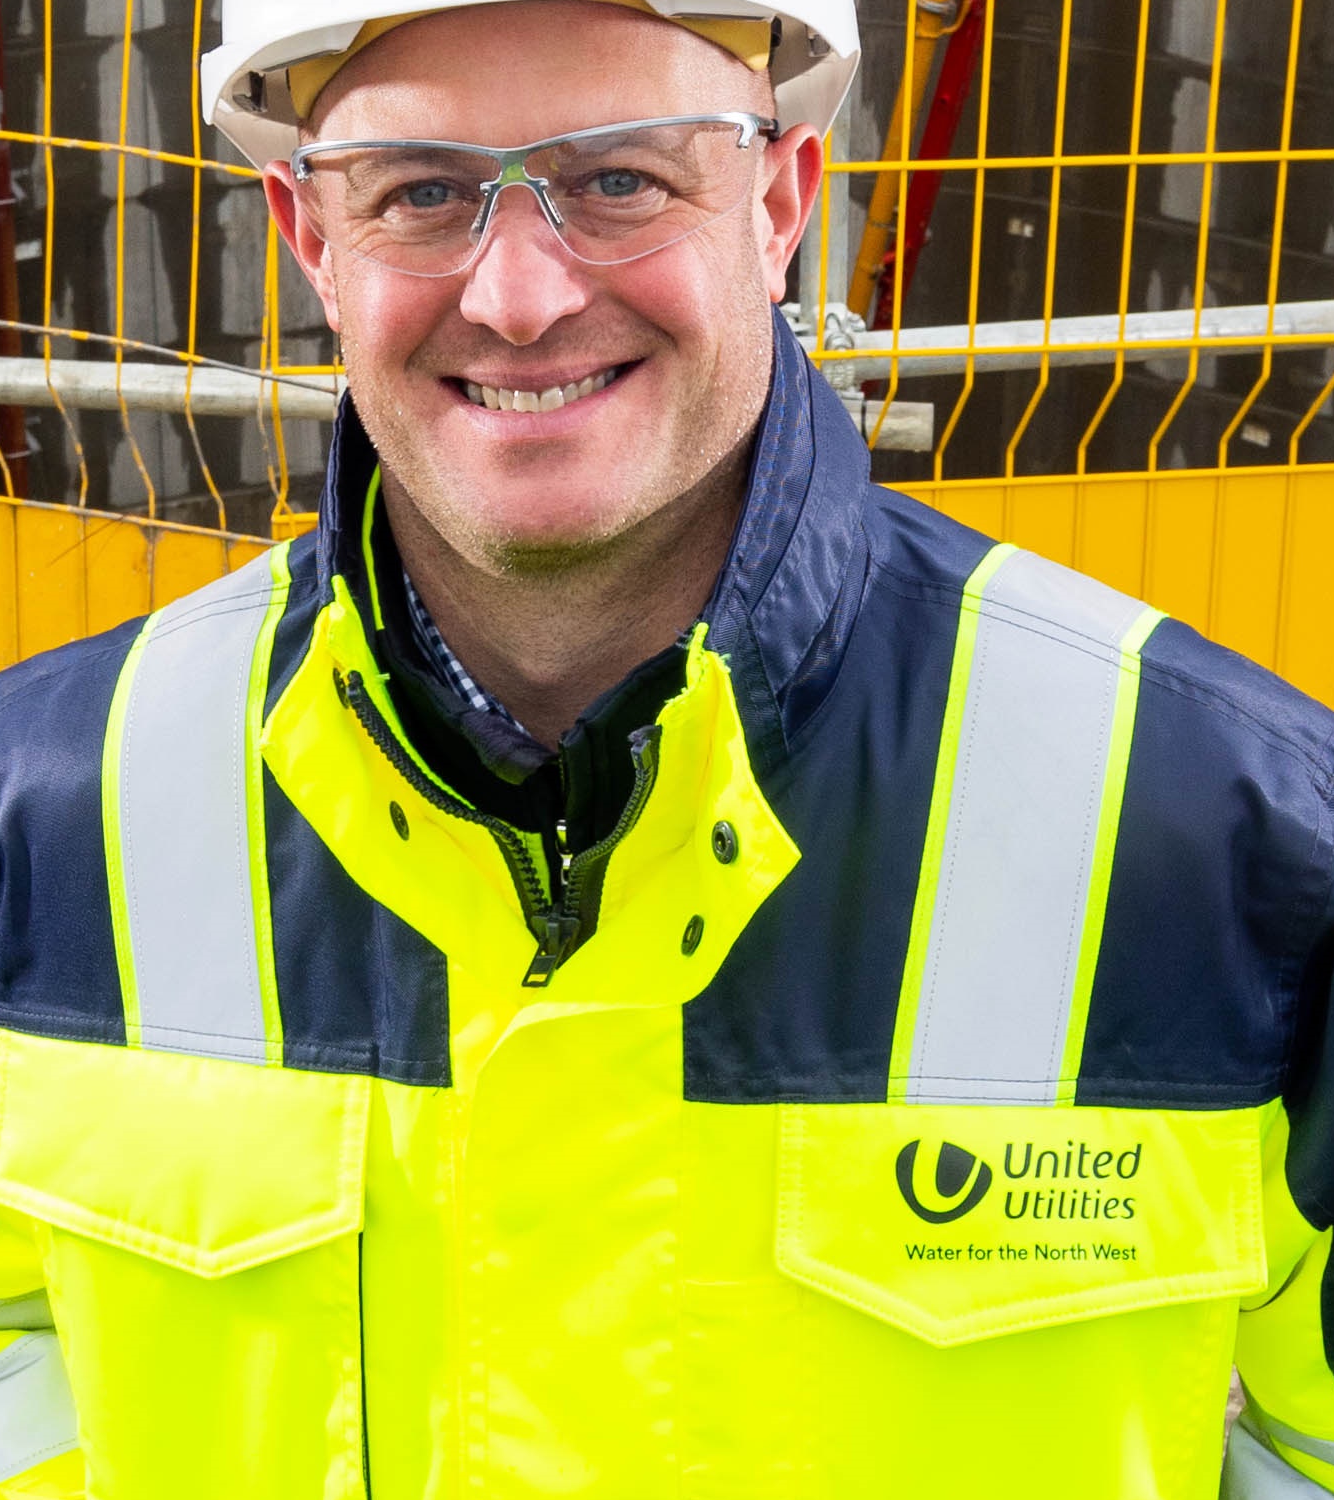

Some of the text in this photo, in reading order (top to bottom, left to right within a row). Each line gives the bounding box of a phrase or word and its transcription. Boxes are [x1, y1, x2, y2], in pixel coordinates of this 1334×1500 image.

[1004, 1140, 1142, 1179] United
[1005, 1189, 1136, 1219] Utilities
[906, 1244, 1137, 1261] Water for the North West
